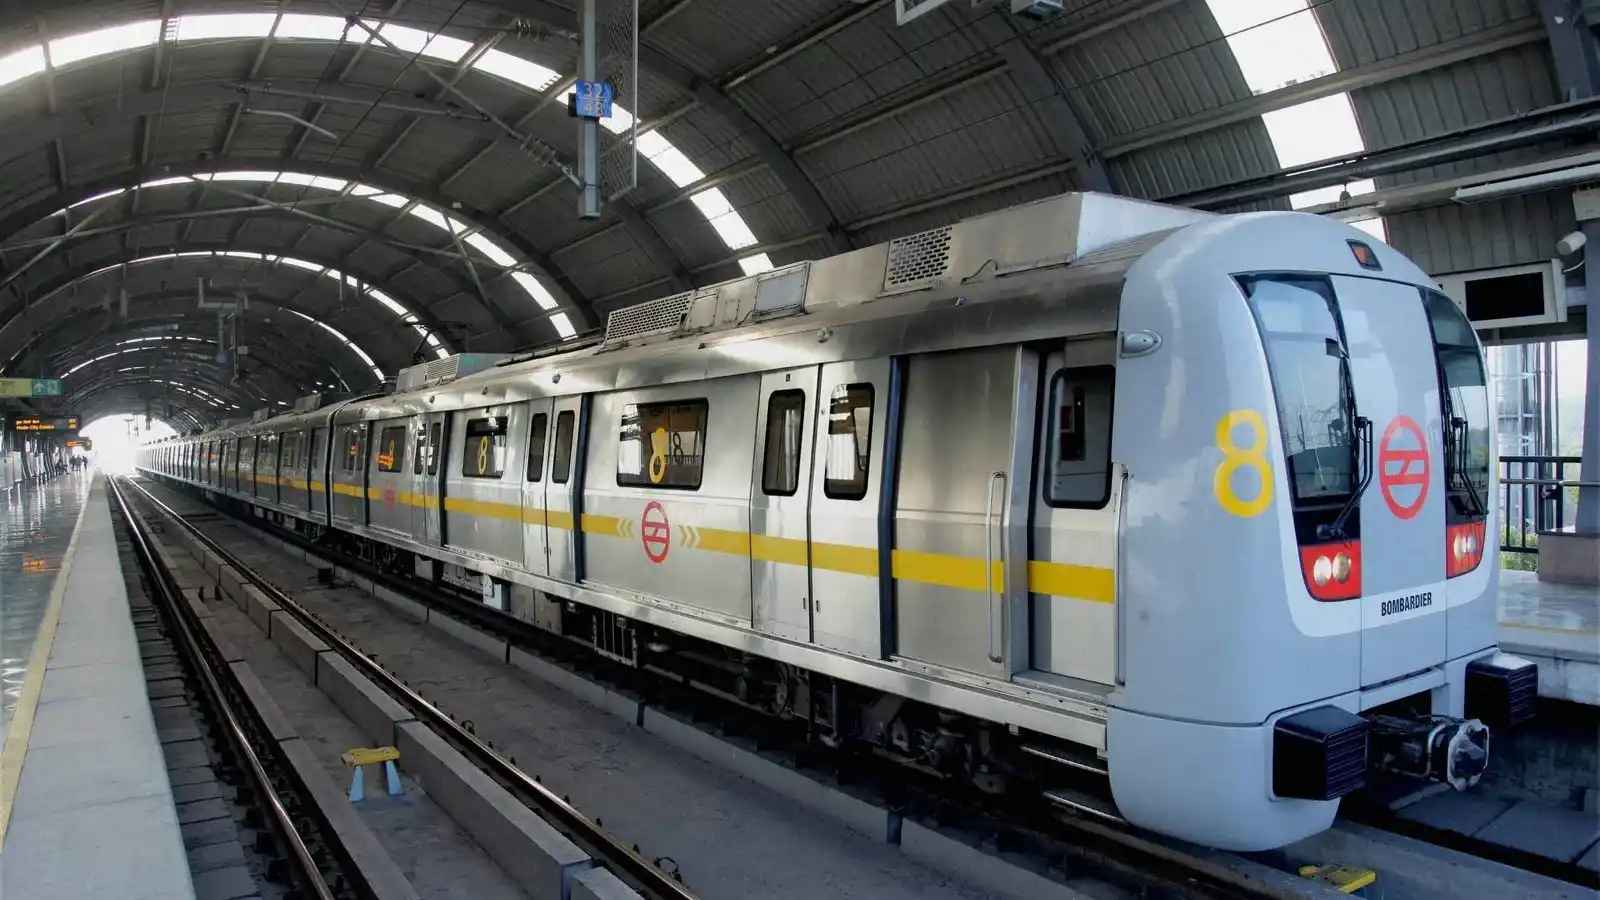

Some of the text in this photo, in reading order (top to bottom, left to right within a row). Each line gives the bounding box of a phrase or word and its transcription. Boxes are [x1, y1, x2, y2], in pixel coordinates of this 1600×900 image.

[478, 436, 488, 475] 8
[649, 426, 667, 484] 8
[1214, 409, 1275, 517] 8
[1381, 592, 1432, 617] BOMBARDIER
